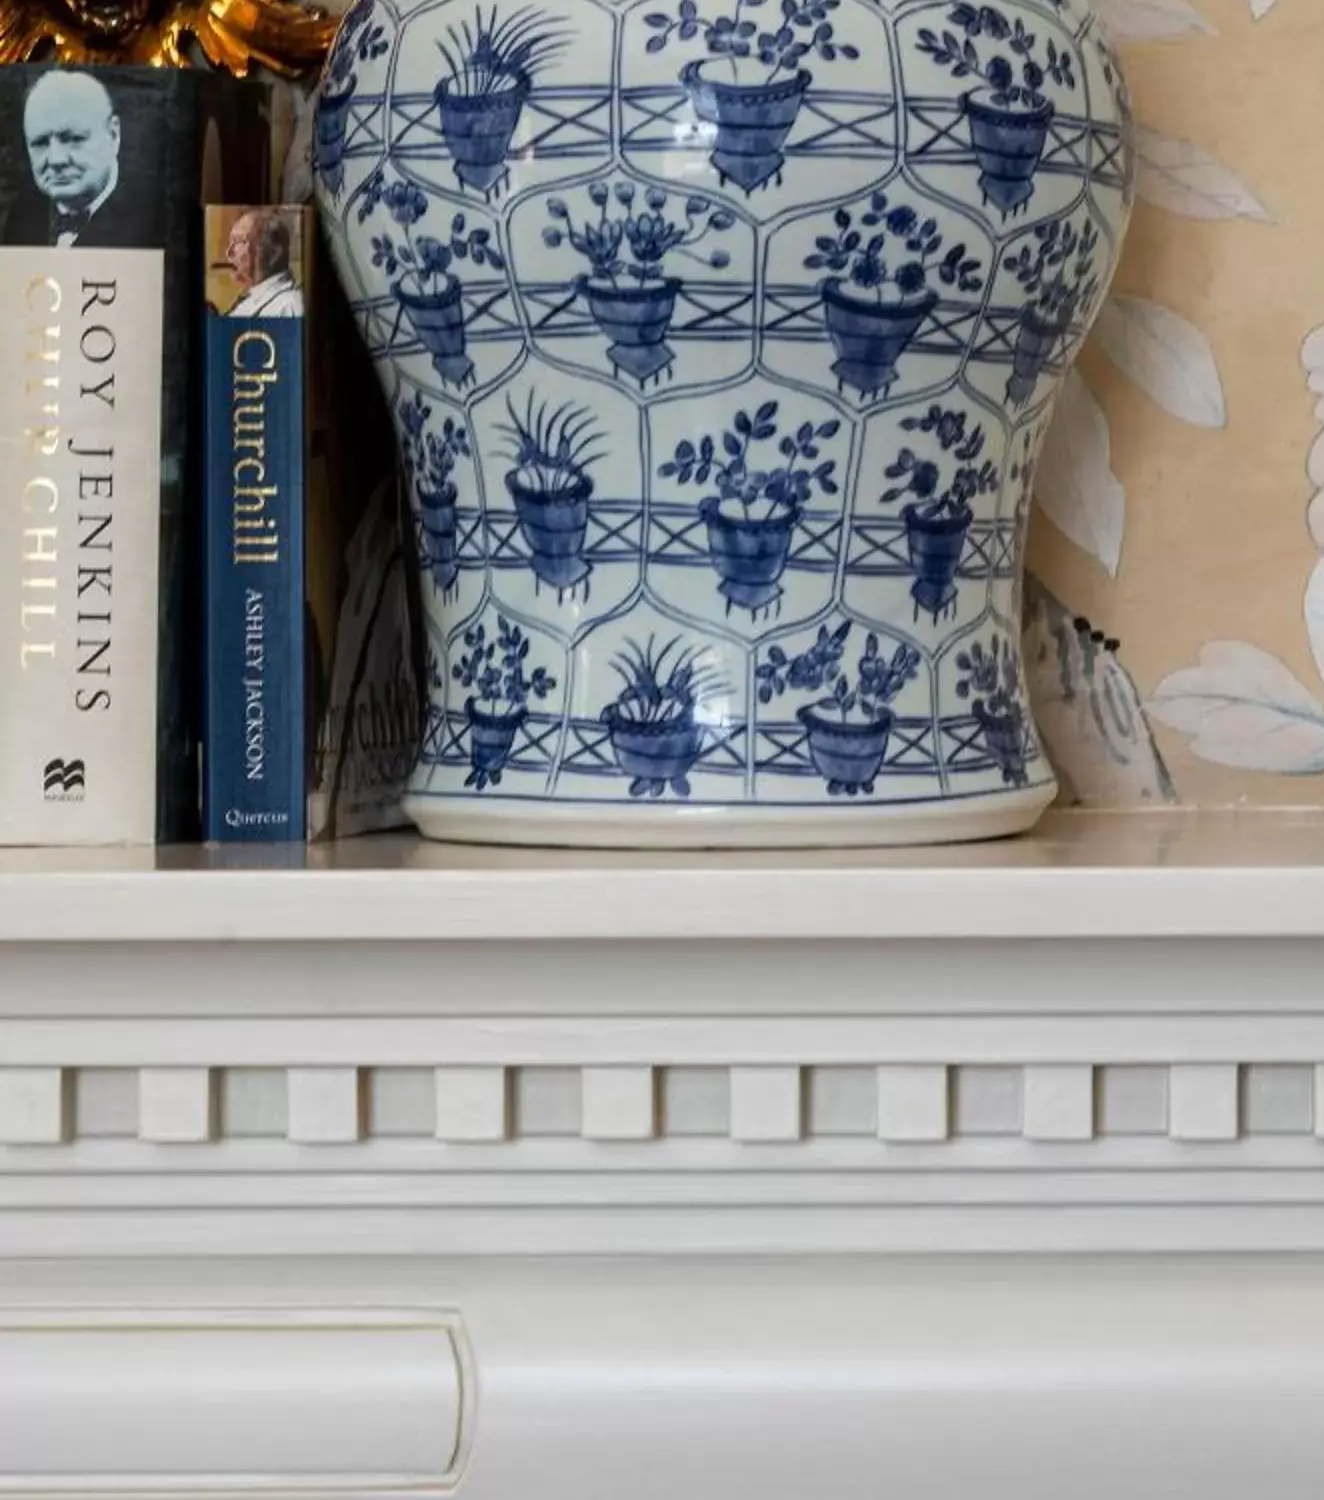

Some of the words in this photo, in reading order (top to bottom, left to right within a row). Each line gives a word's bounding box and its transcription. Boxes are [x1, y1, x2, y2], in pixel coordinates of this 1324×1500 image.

[79, 278, 117, 411] ROY
[233, 330, 279, 565] Churchill
[67, 436, 115, 711] JENKINS
[244, 588, 264, 671] ASHLEY
[243, 676, 264, 781] JACKSON
